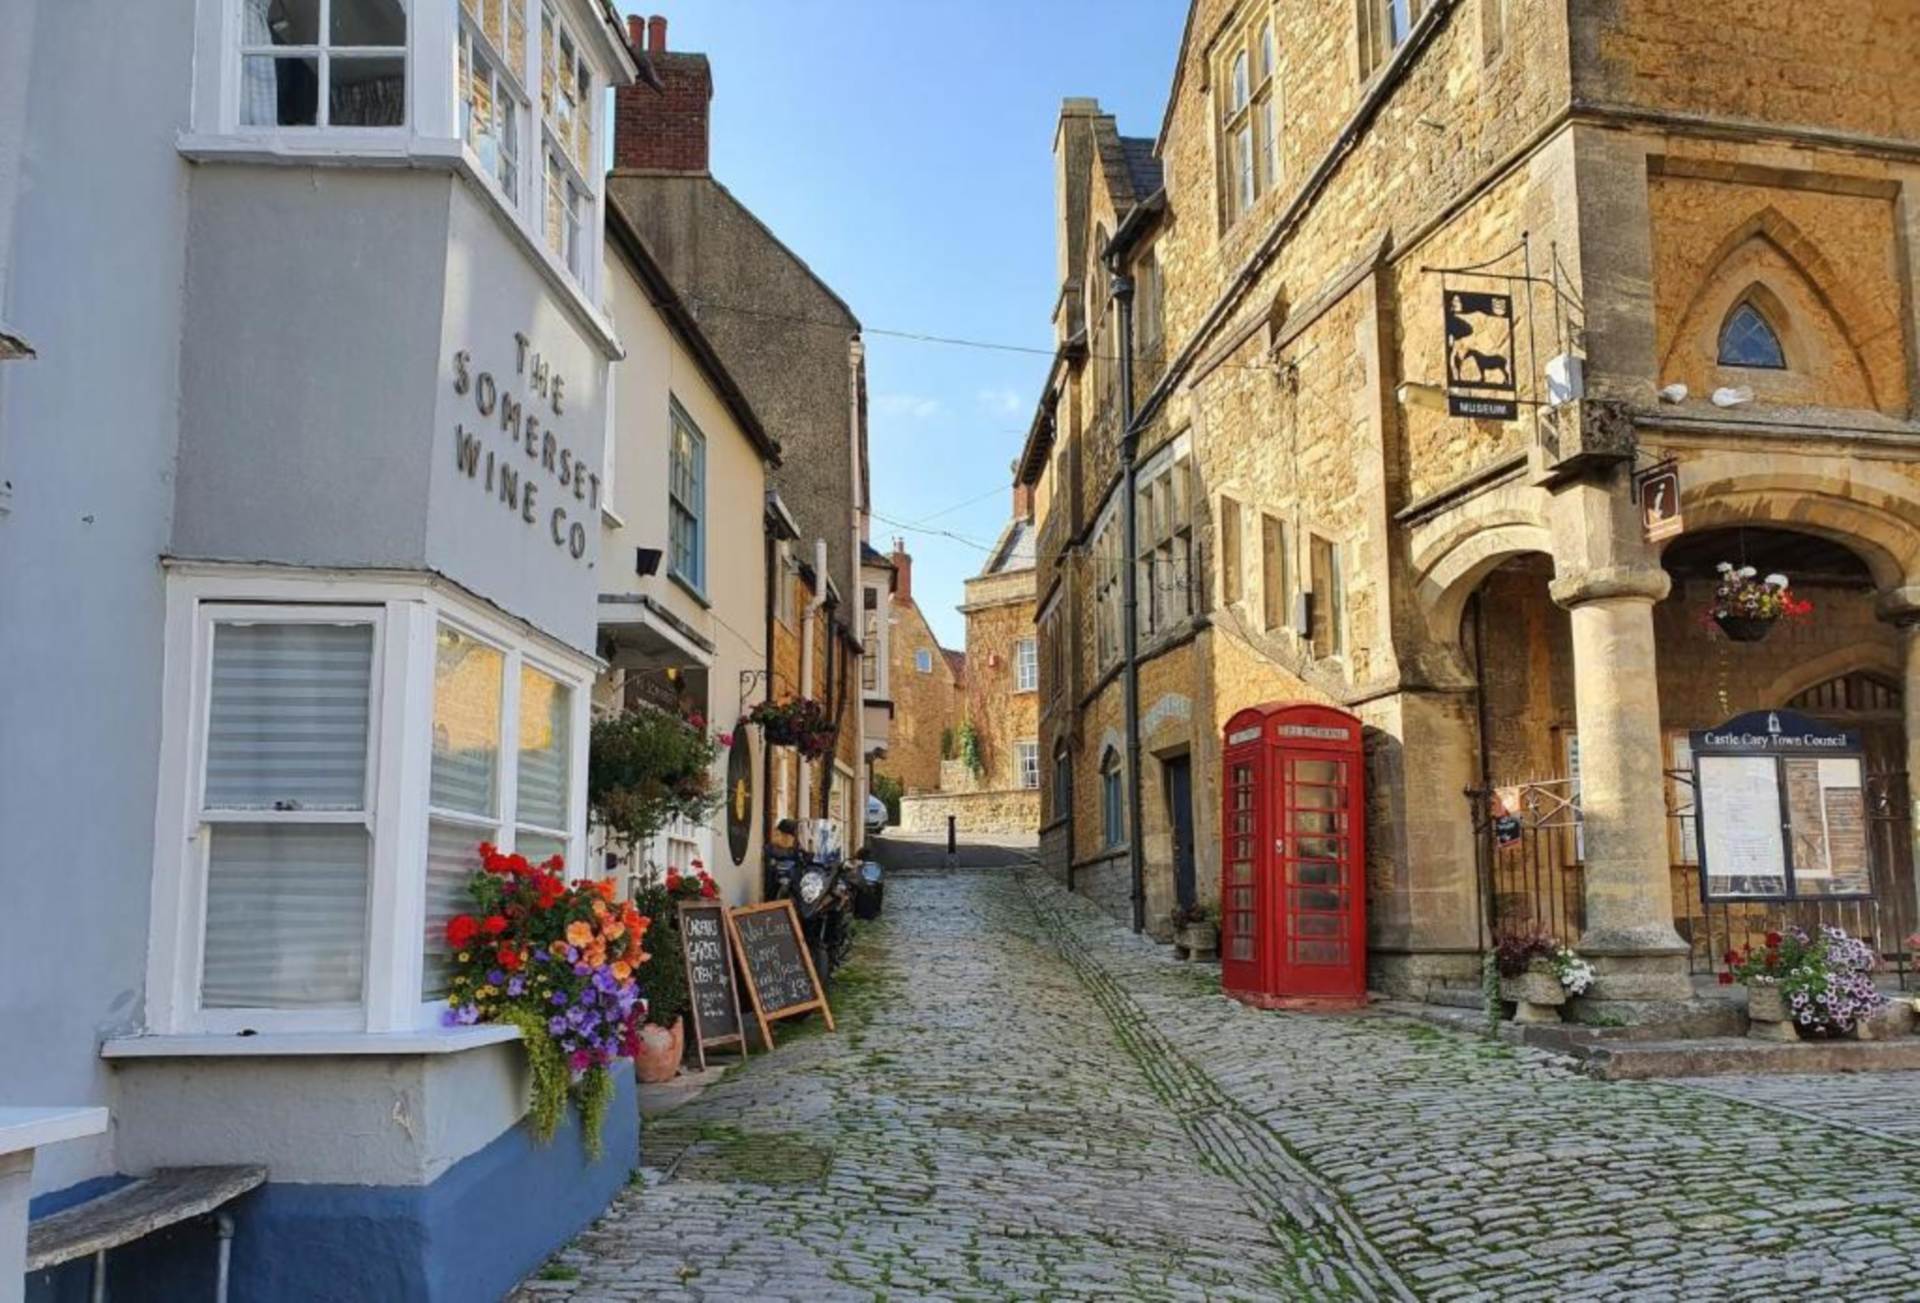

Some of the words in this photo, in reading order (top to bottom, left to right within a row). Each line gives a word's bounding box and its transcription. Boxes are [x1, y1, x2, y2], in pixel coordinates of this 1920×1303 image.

[514, 331, 564, 416] THE
[1459, 402, 1506, 415] MUSEUM
[453, 350, 600, 510] SOMERSET
[455, 424, 539, 524] WINE
[550, 507, 594, 569] CO.
[1704, 732, 1738, 745] Castle
[1741, 733, 1769, 749] Cary
[1771, 734, 1802, 746] Town
[1804, 733, 1847, 747] Council
